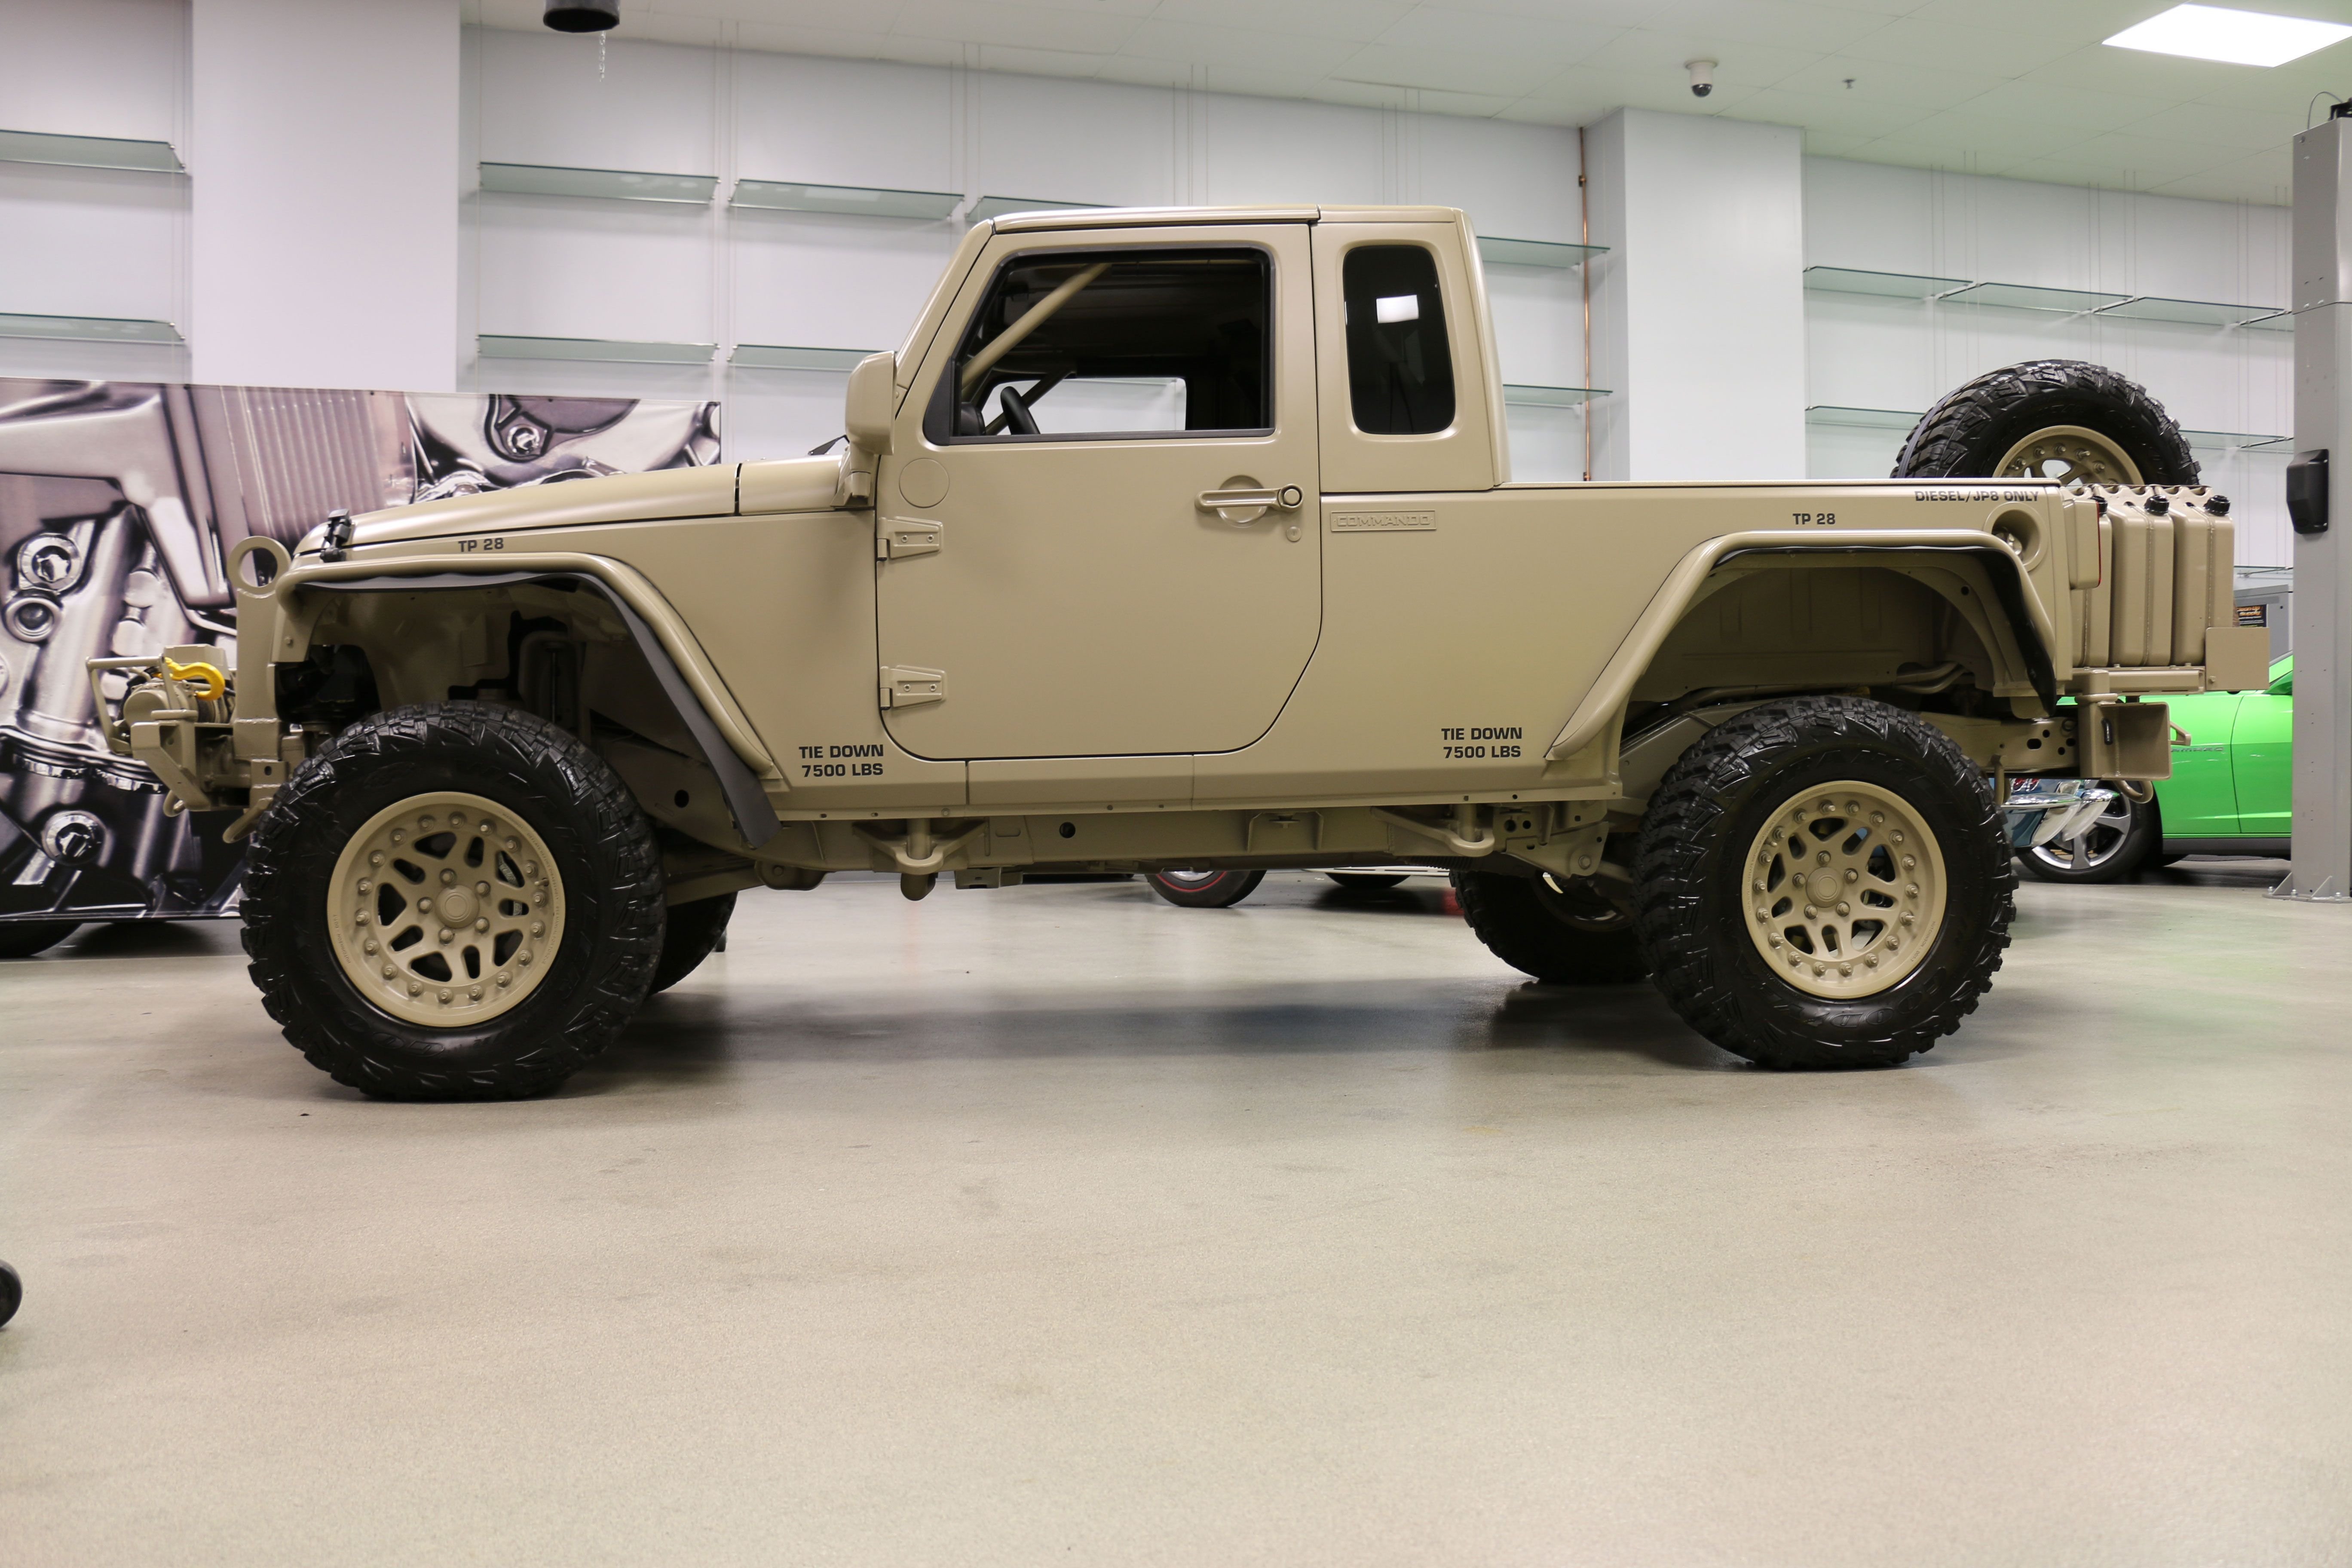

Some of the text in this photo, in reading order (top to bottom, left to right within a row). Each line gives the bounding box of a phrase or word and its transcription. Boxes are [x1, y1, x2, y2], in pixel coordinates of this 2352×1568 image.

[1914, 491, 2039, 502] DIESEL/JP8 ONLY
[1337, 514, 1431, 527] COMMANDO
[1792, 513, 1835, 525] TP 28
[458, 538, 503, 552] TP 28
[1441, 727, 1522, 740] TIE DOWN
[799, 744, 884, 759] TIE DOWN
[1443, 745, 1521, 759] 7500 LBS
[802, 763, 883, 777] 7500 LBS
[1920, 920, 1936, 948] HUTCHINSON
[336, 933, 352, 964] HUTCHINSON
